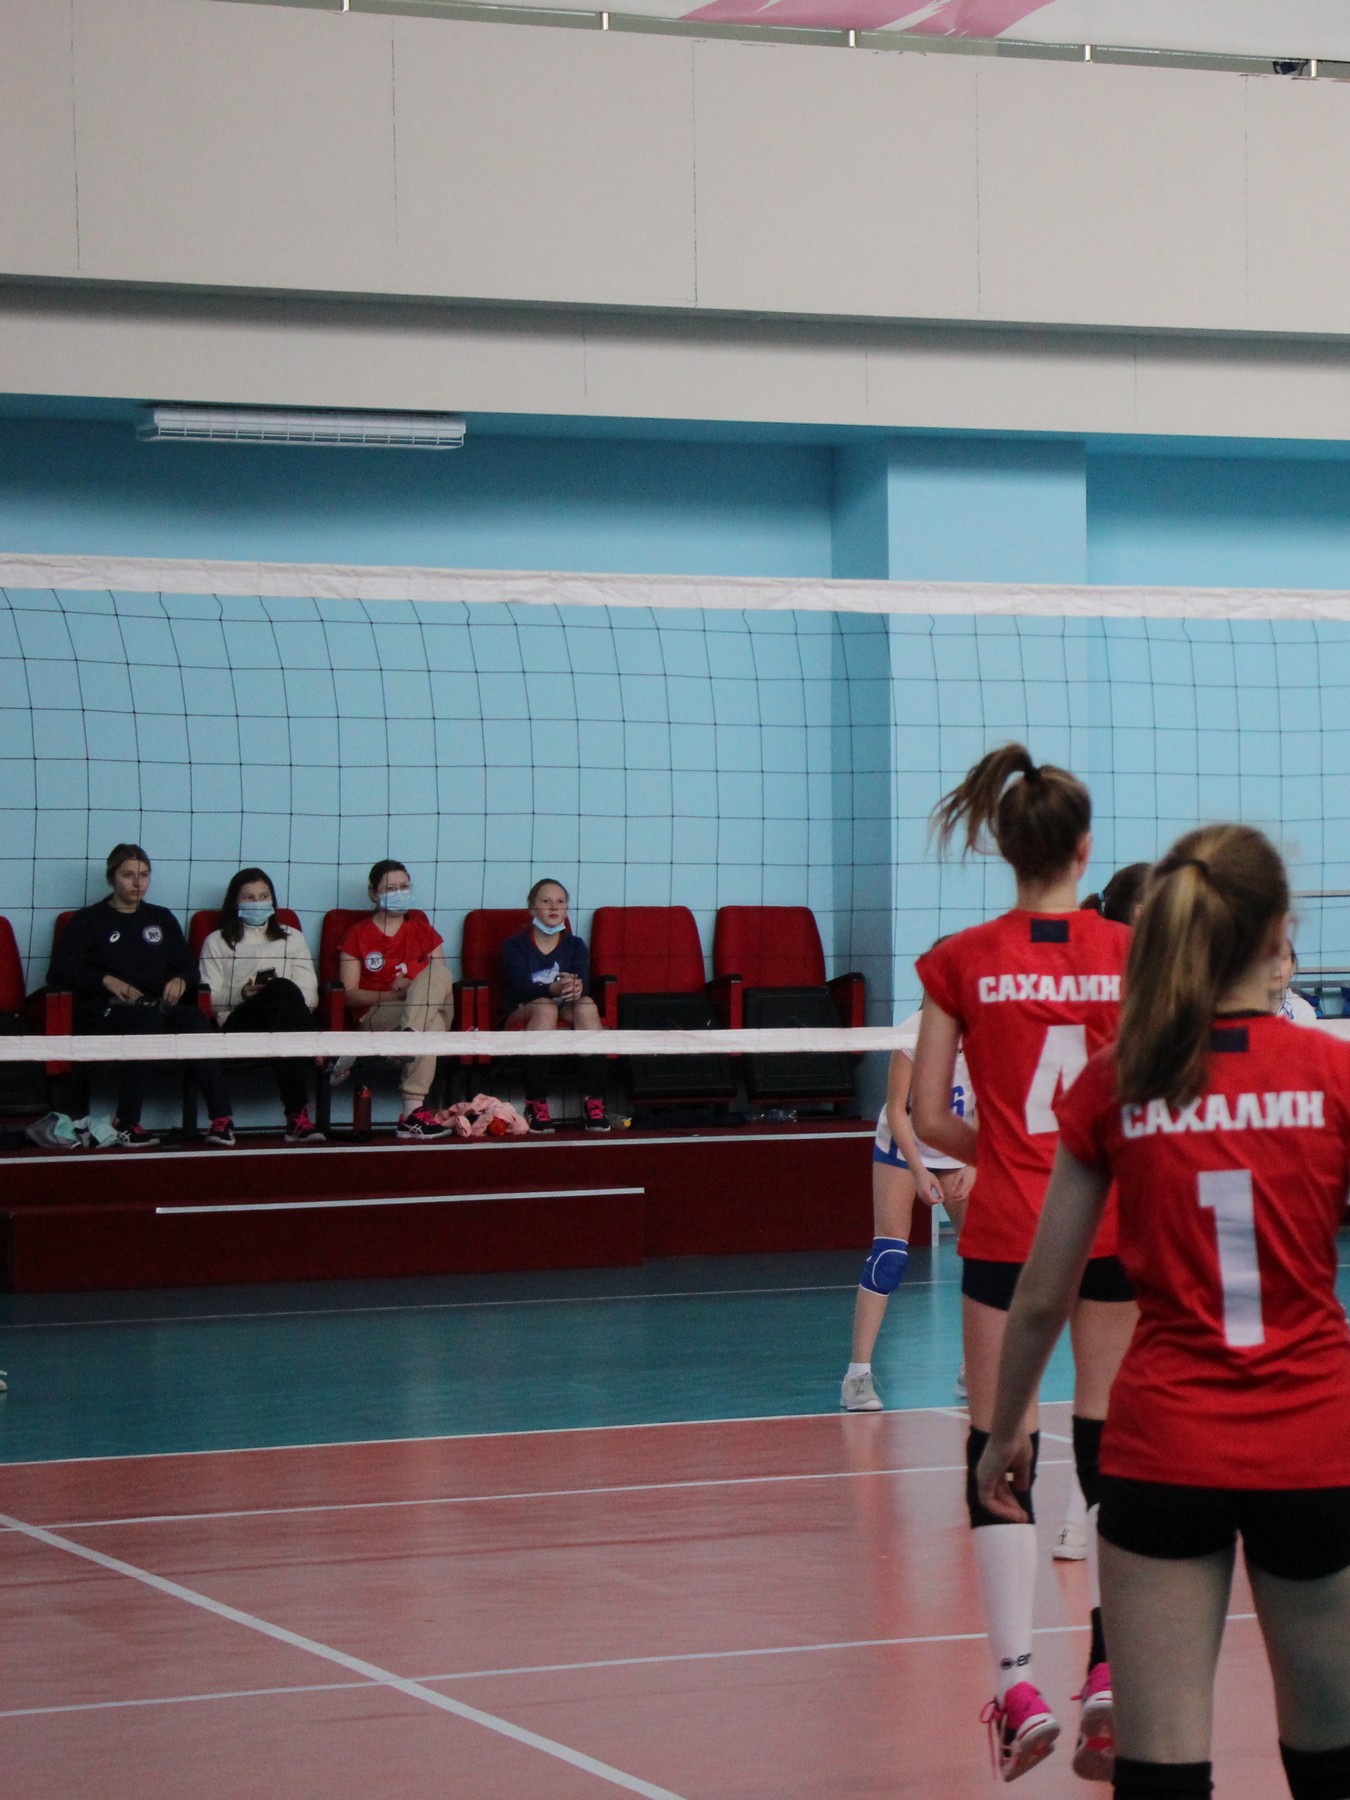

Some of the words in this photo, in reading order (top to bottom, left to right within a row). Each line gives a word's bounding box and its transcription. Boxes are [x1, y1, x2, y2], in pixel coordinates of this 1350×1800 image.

[978, 974, 1121, 1004] САХАЛИН
[1025, 1024, 1088, 1135] 4
[1121, 1090, 1326, 1139] САХАЛИН
[1197, 1169, 1266, 1347] 1
